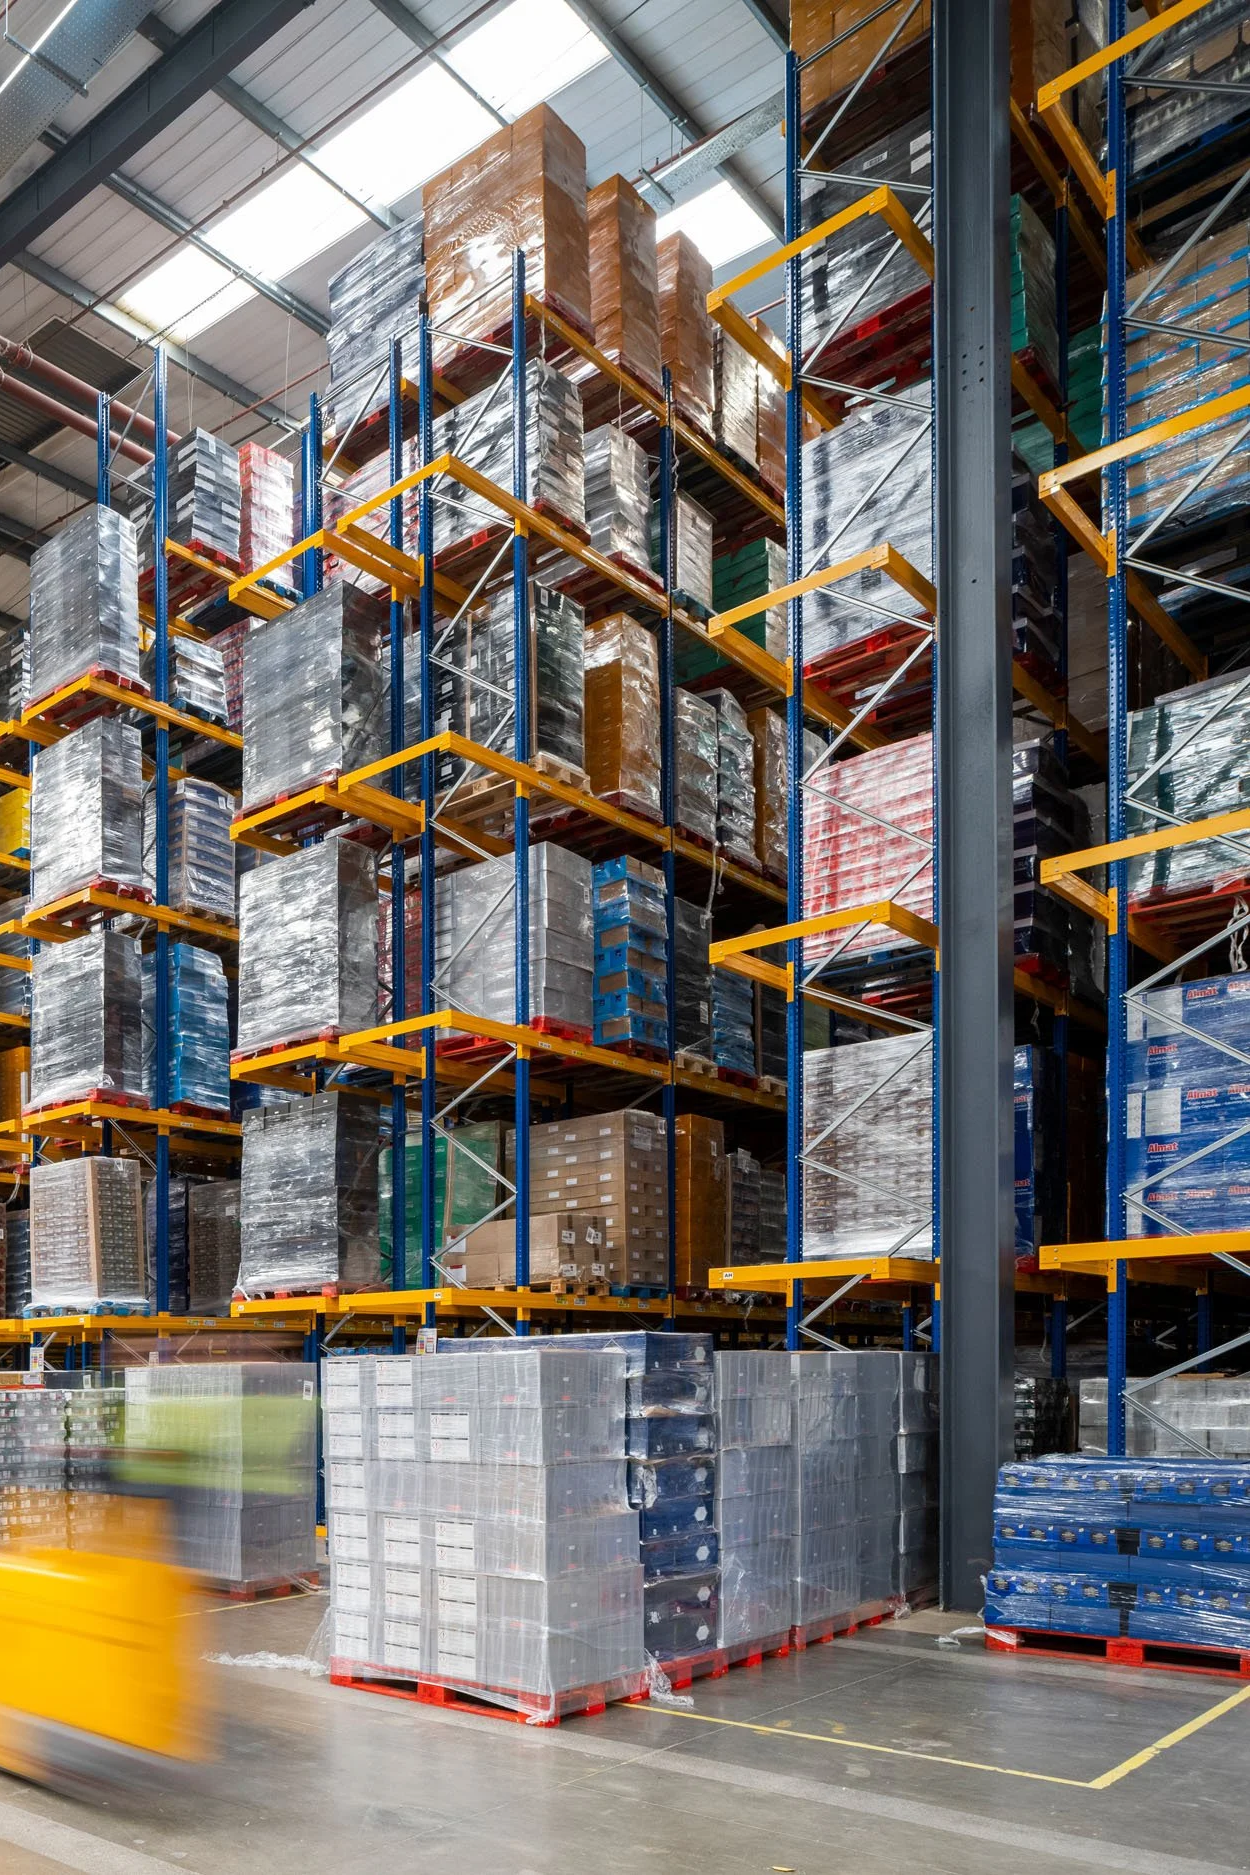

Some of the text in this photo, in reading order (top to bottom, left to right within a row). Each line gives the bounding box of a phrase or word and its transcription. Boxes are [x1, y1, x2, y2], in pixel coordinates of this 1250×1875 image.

[1187, 987, 1218, 999] Almat
[1148, 1044, 1177, 1055] Almat
[1187, 1088, 1218, 1100] Almat
[1147, 1142, 1178, 1153] Almat
